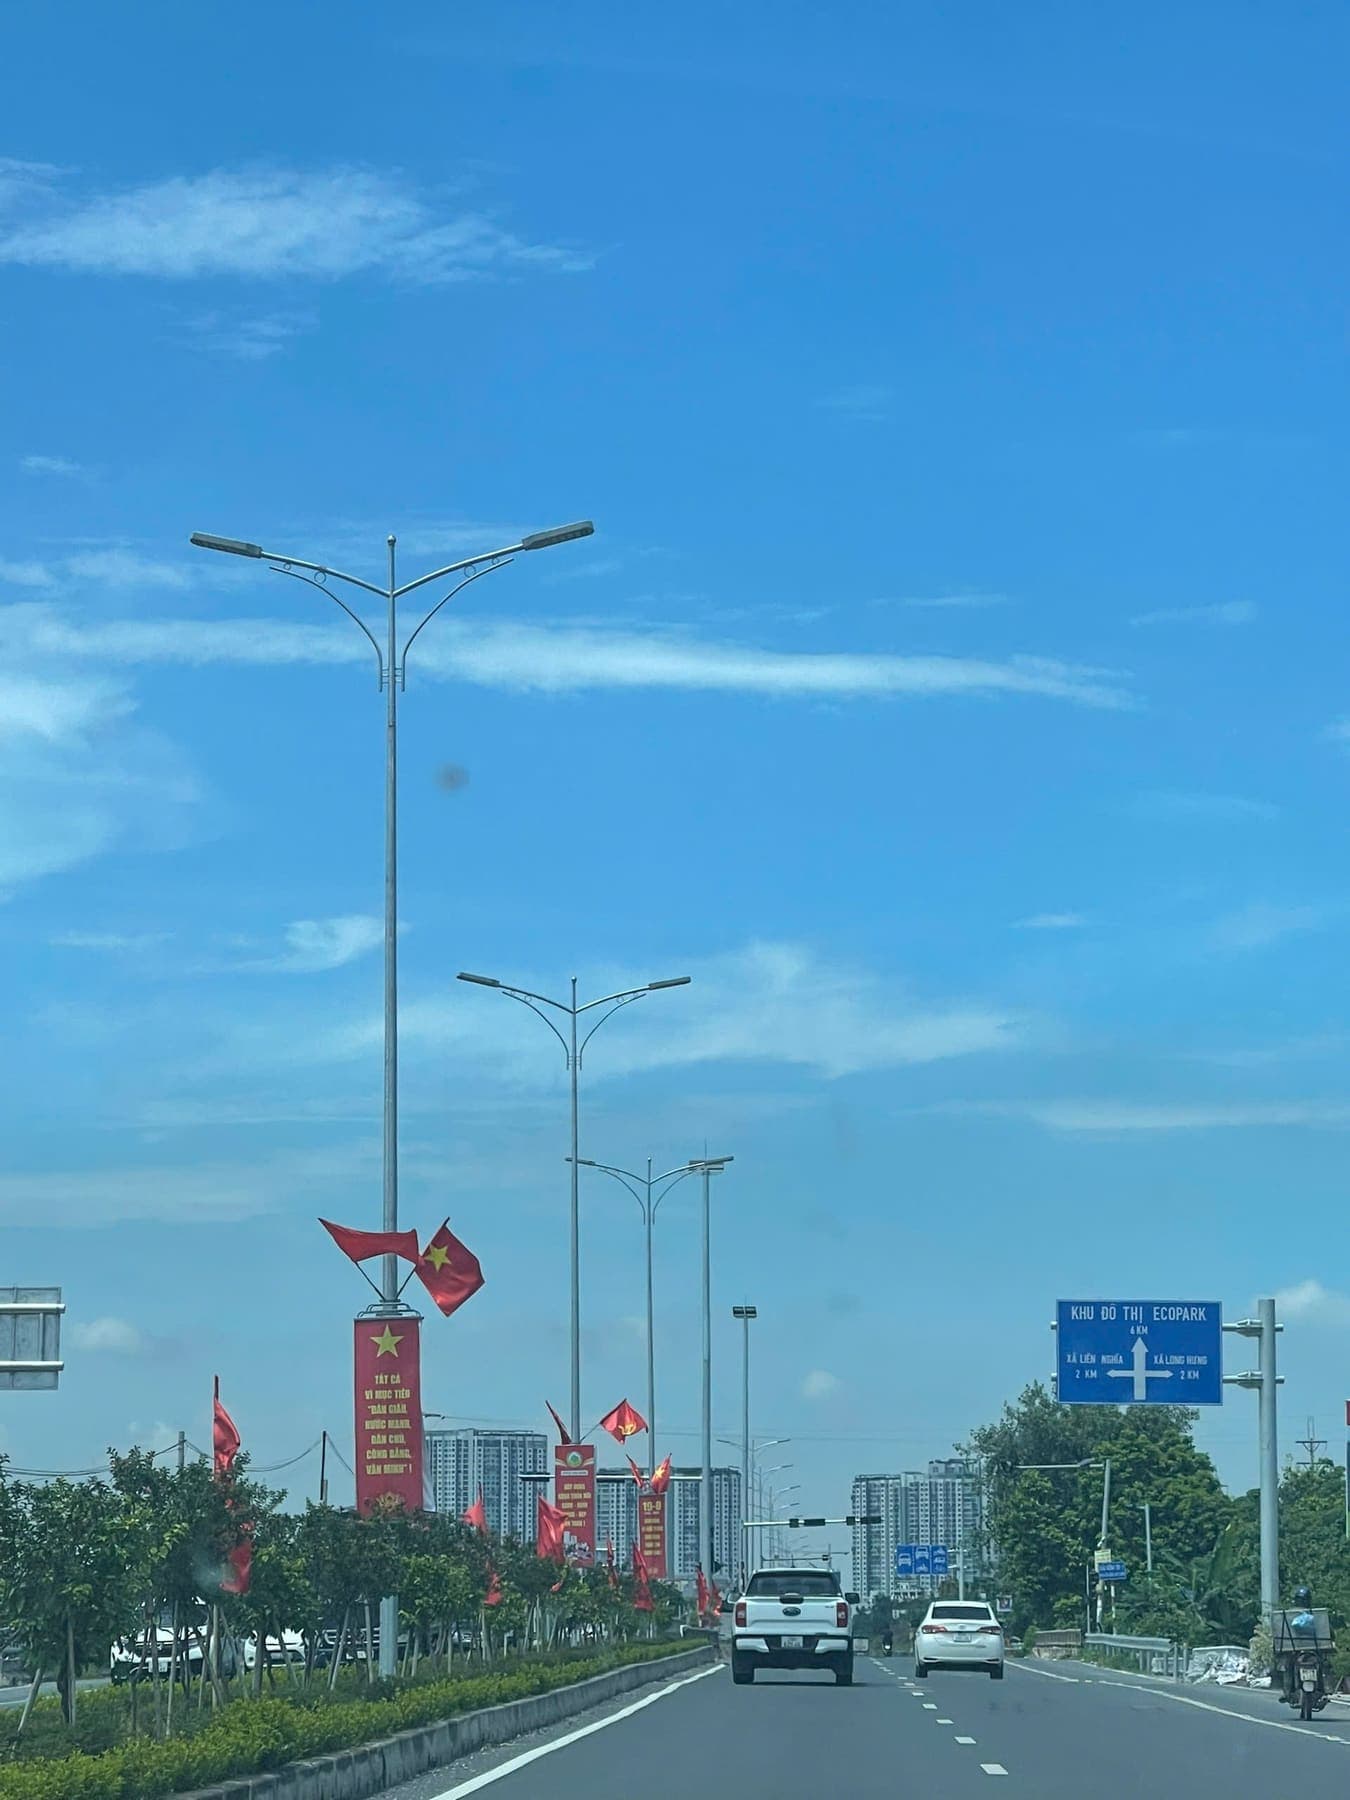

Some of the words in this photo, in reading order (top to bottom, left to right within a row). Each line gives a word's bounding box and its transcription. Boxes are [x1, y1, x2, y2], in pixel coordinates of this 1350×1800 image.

[1071, 1305, 1094, 1320] KHU
[1100, 1303, 1116, 1320] ĐÔ
[1122, 1306, 1143, 1323] THỊ
[1153, 1306, 1207, 1321] ECOPARK
[1136, 1325, 1148, 1334] KM
[1075, 1369, 1080, 1379] 2
[1085, 1369, 1097, 1379] KM
[1180, 1370, 1185, 1380] 2
[1187, 1370, 1200, 1380] KM
